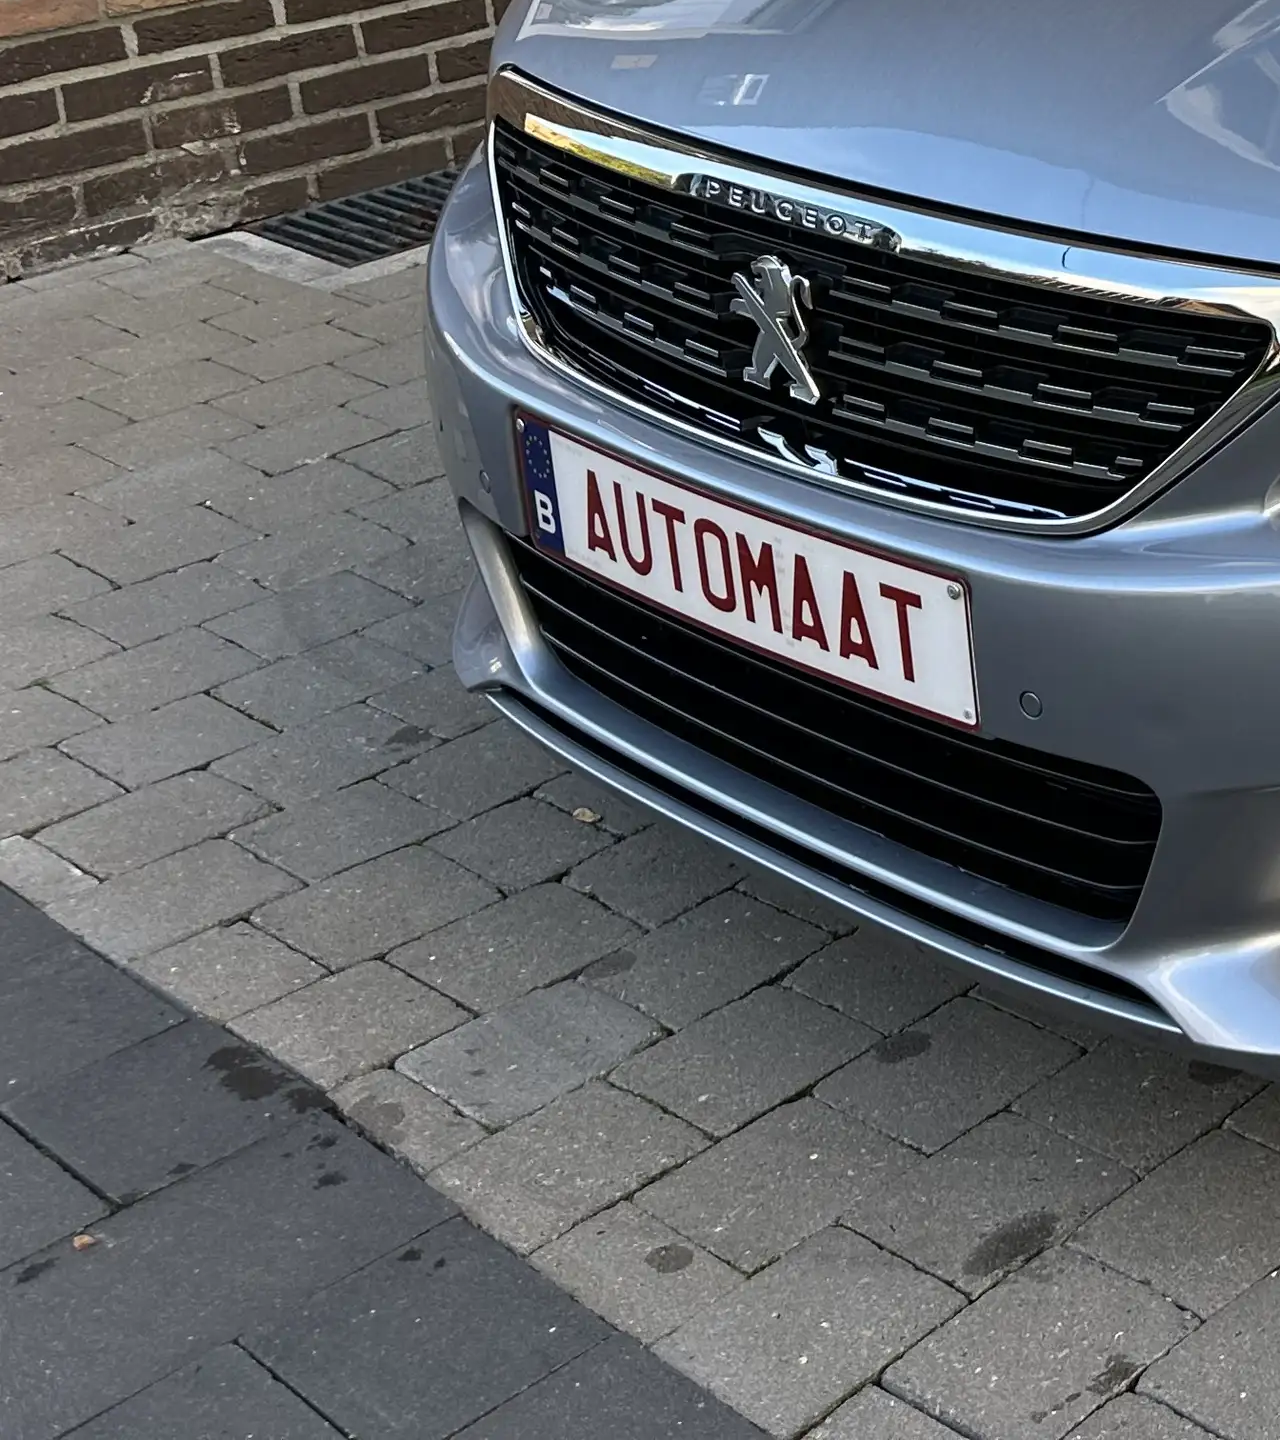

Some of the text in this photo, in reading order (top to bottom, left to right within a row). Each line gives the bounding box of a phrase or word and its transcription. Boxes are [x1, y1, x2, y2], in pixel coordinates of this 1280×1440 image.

[704, 178, 873, 242] PEUGEOT
[533, 488, 558, 536] B
[585, 468, 924, 684] AUTOMAAT
